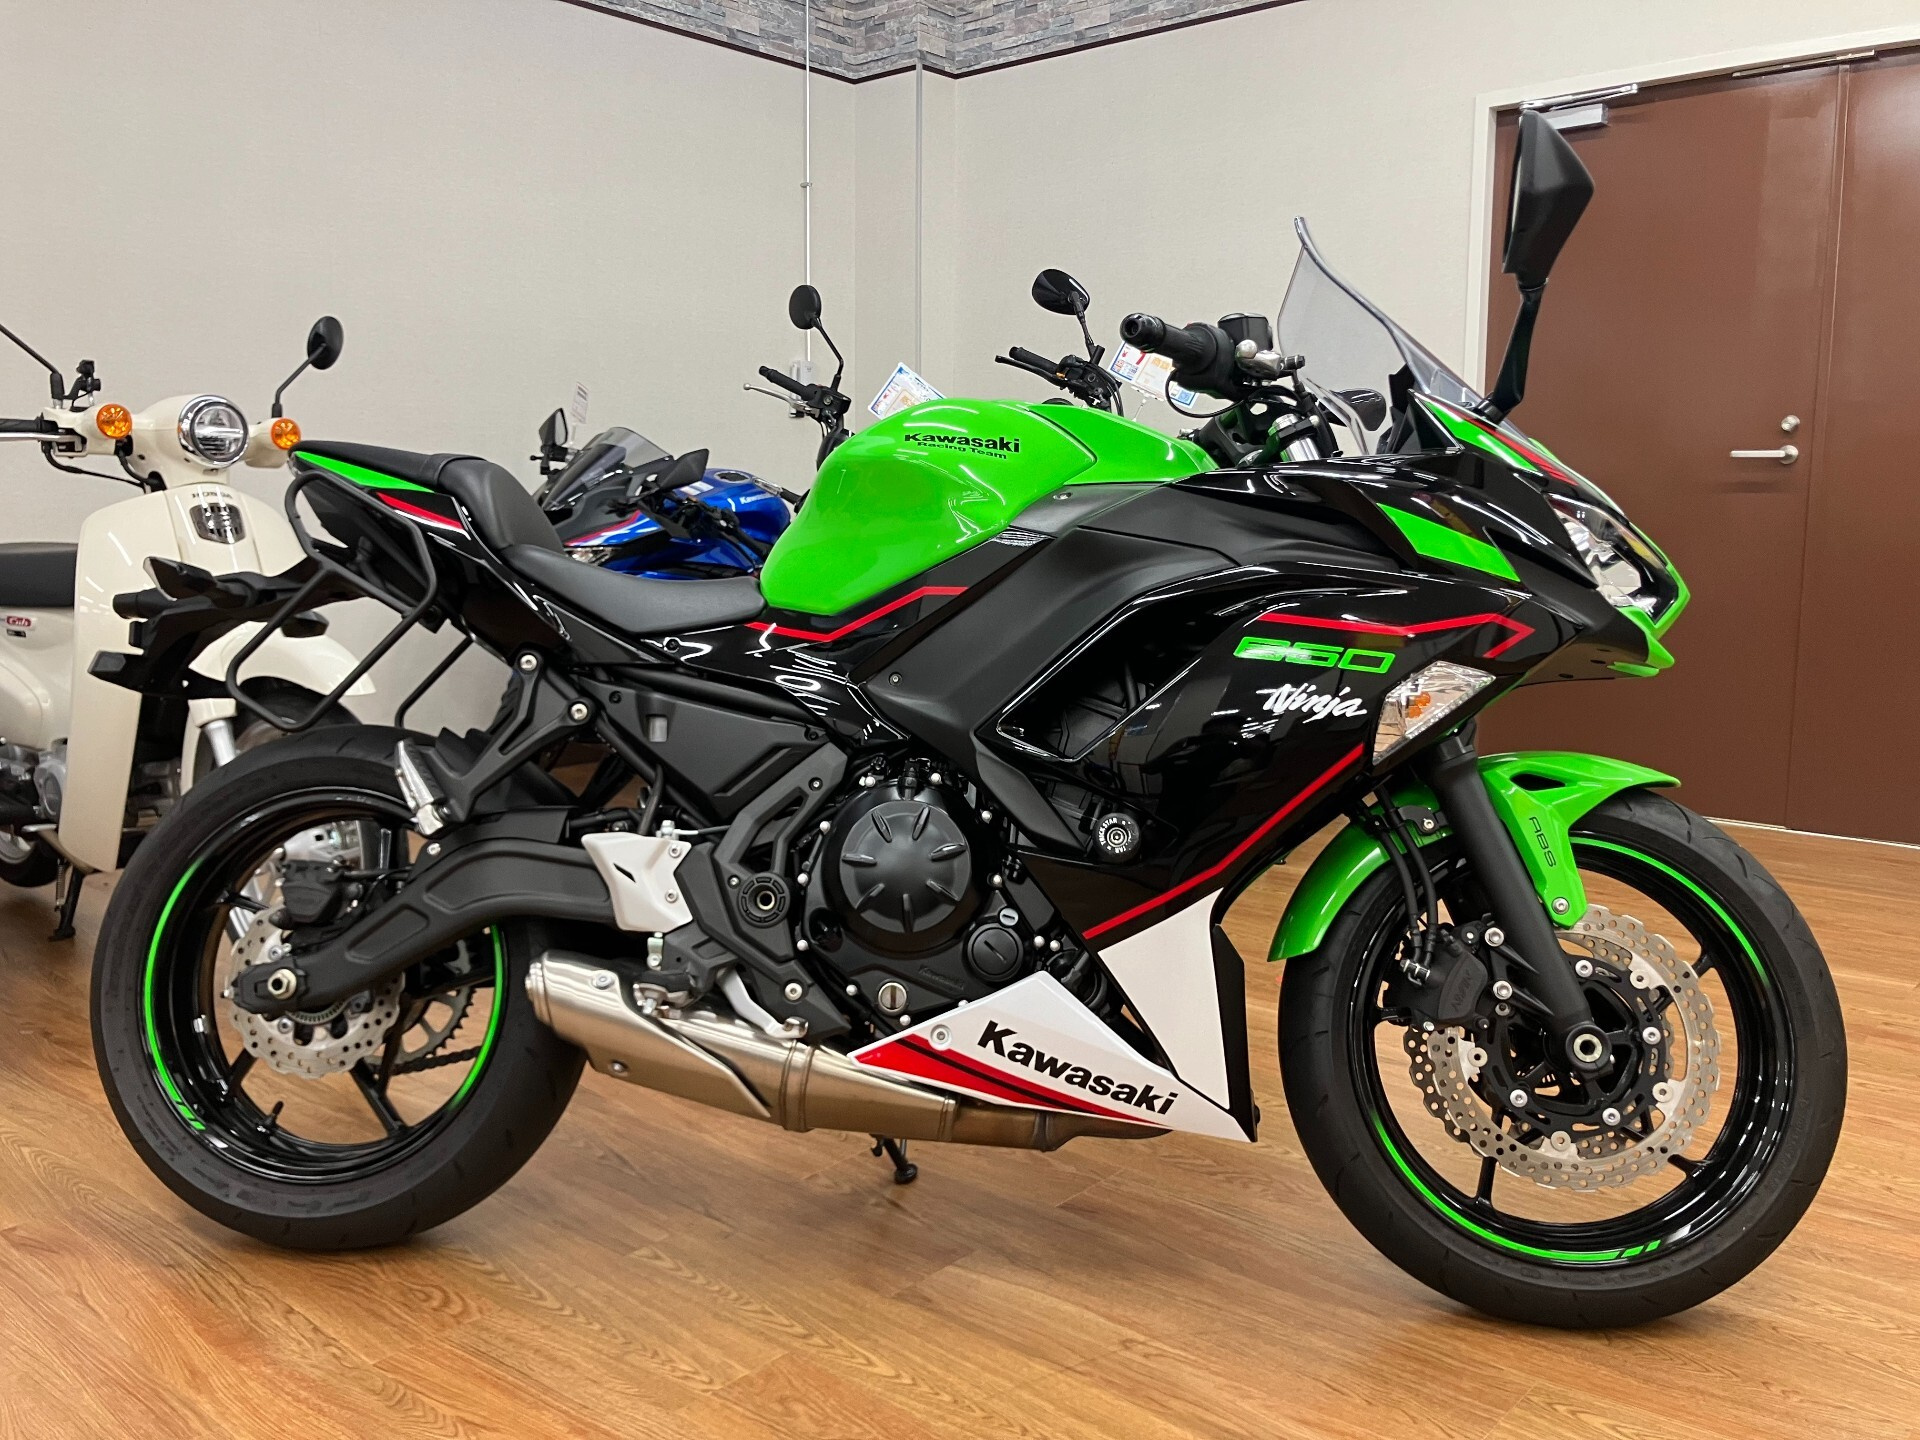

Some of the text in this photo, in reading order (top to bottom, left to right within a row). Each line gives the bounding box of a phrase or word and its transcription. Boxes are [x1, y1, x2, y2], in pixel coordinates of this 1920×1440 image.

[904, 432, 1020, 453] Kawasaki
[917, 441, 1007, 459] Racing Team
[1233, 636, 1396, 674] 650
[1255, 682, 1368, 724] Ninja
[1528, 816, 1557, 867] ABS
[977, 1019, 1179, 1115] Kawasaki
